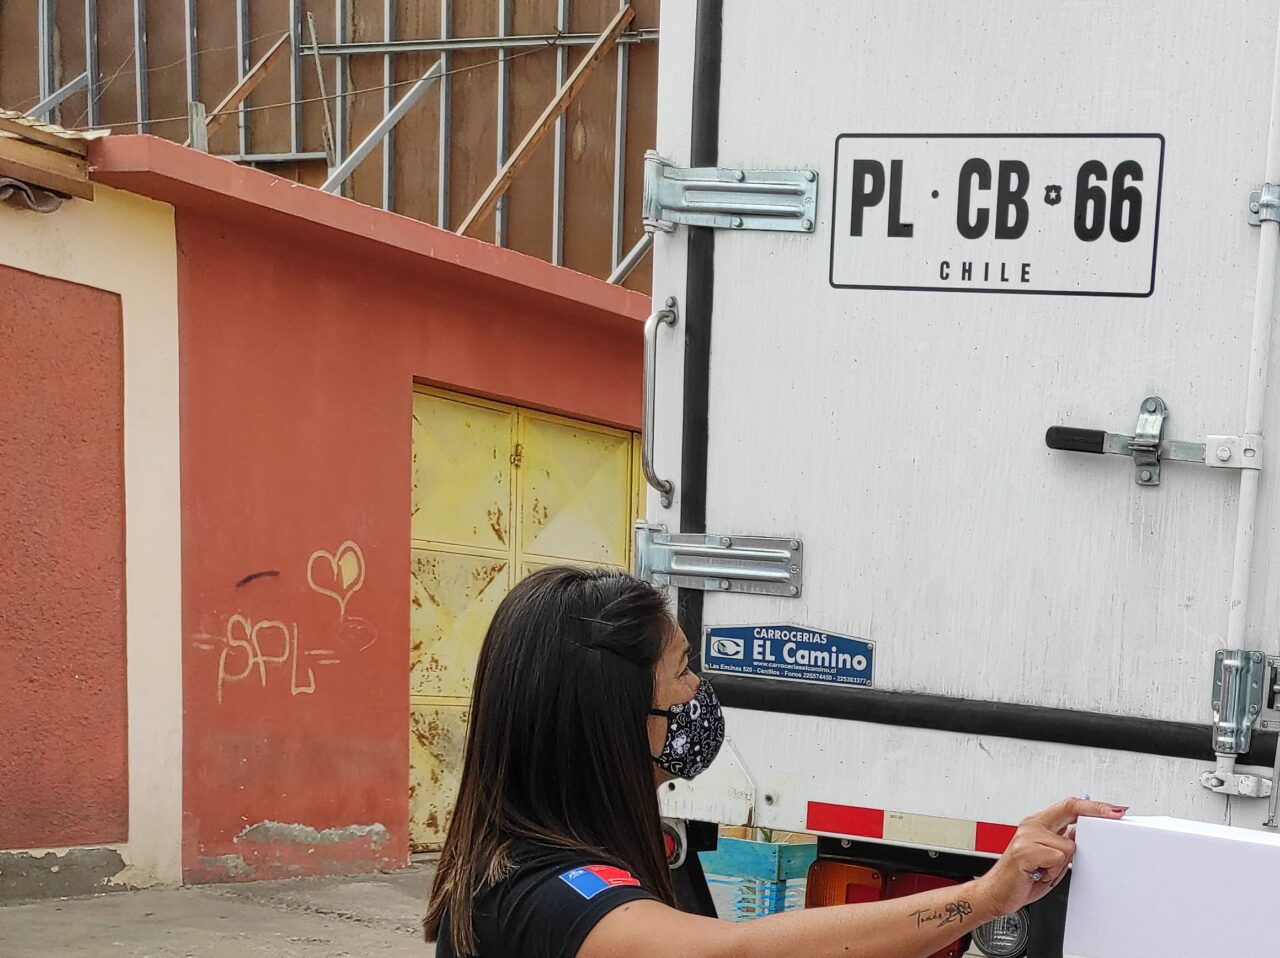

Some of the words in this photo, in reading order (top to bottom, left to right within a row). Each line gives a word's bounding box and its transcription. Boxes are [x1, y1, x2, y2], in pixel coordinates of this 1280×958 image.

[849, 159, 914, 238] PL
[956, 157, 1030, 240] CB
[1073, 159, 1144, 243] 66
[939, 260, 1031, 283] CHILE
[753, 627, 828, 645] CARROCERIAS
[752, 638, 776, 662] EL
[782, 642, 867, 672] Camino
